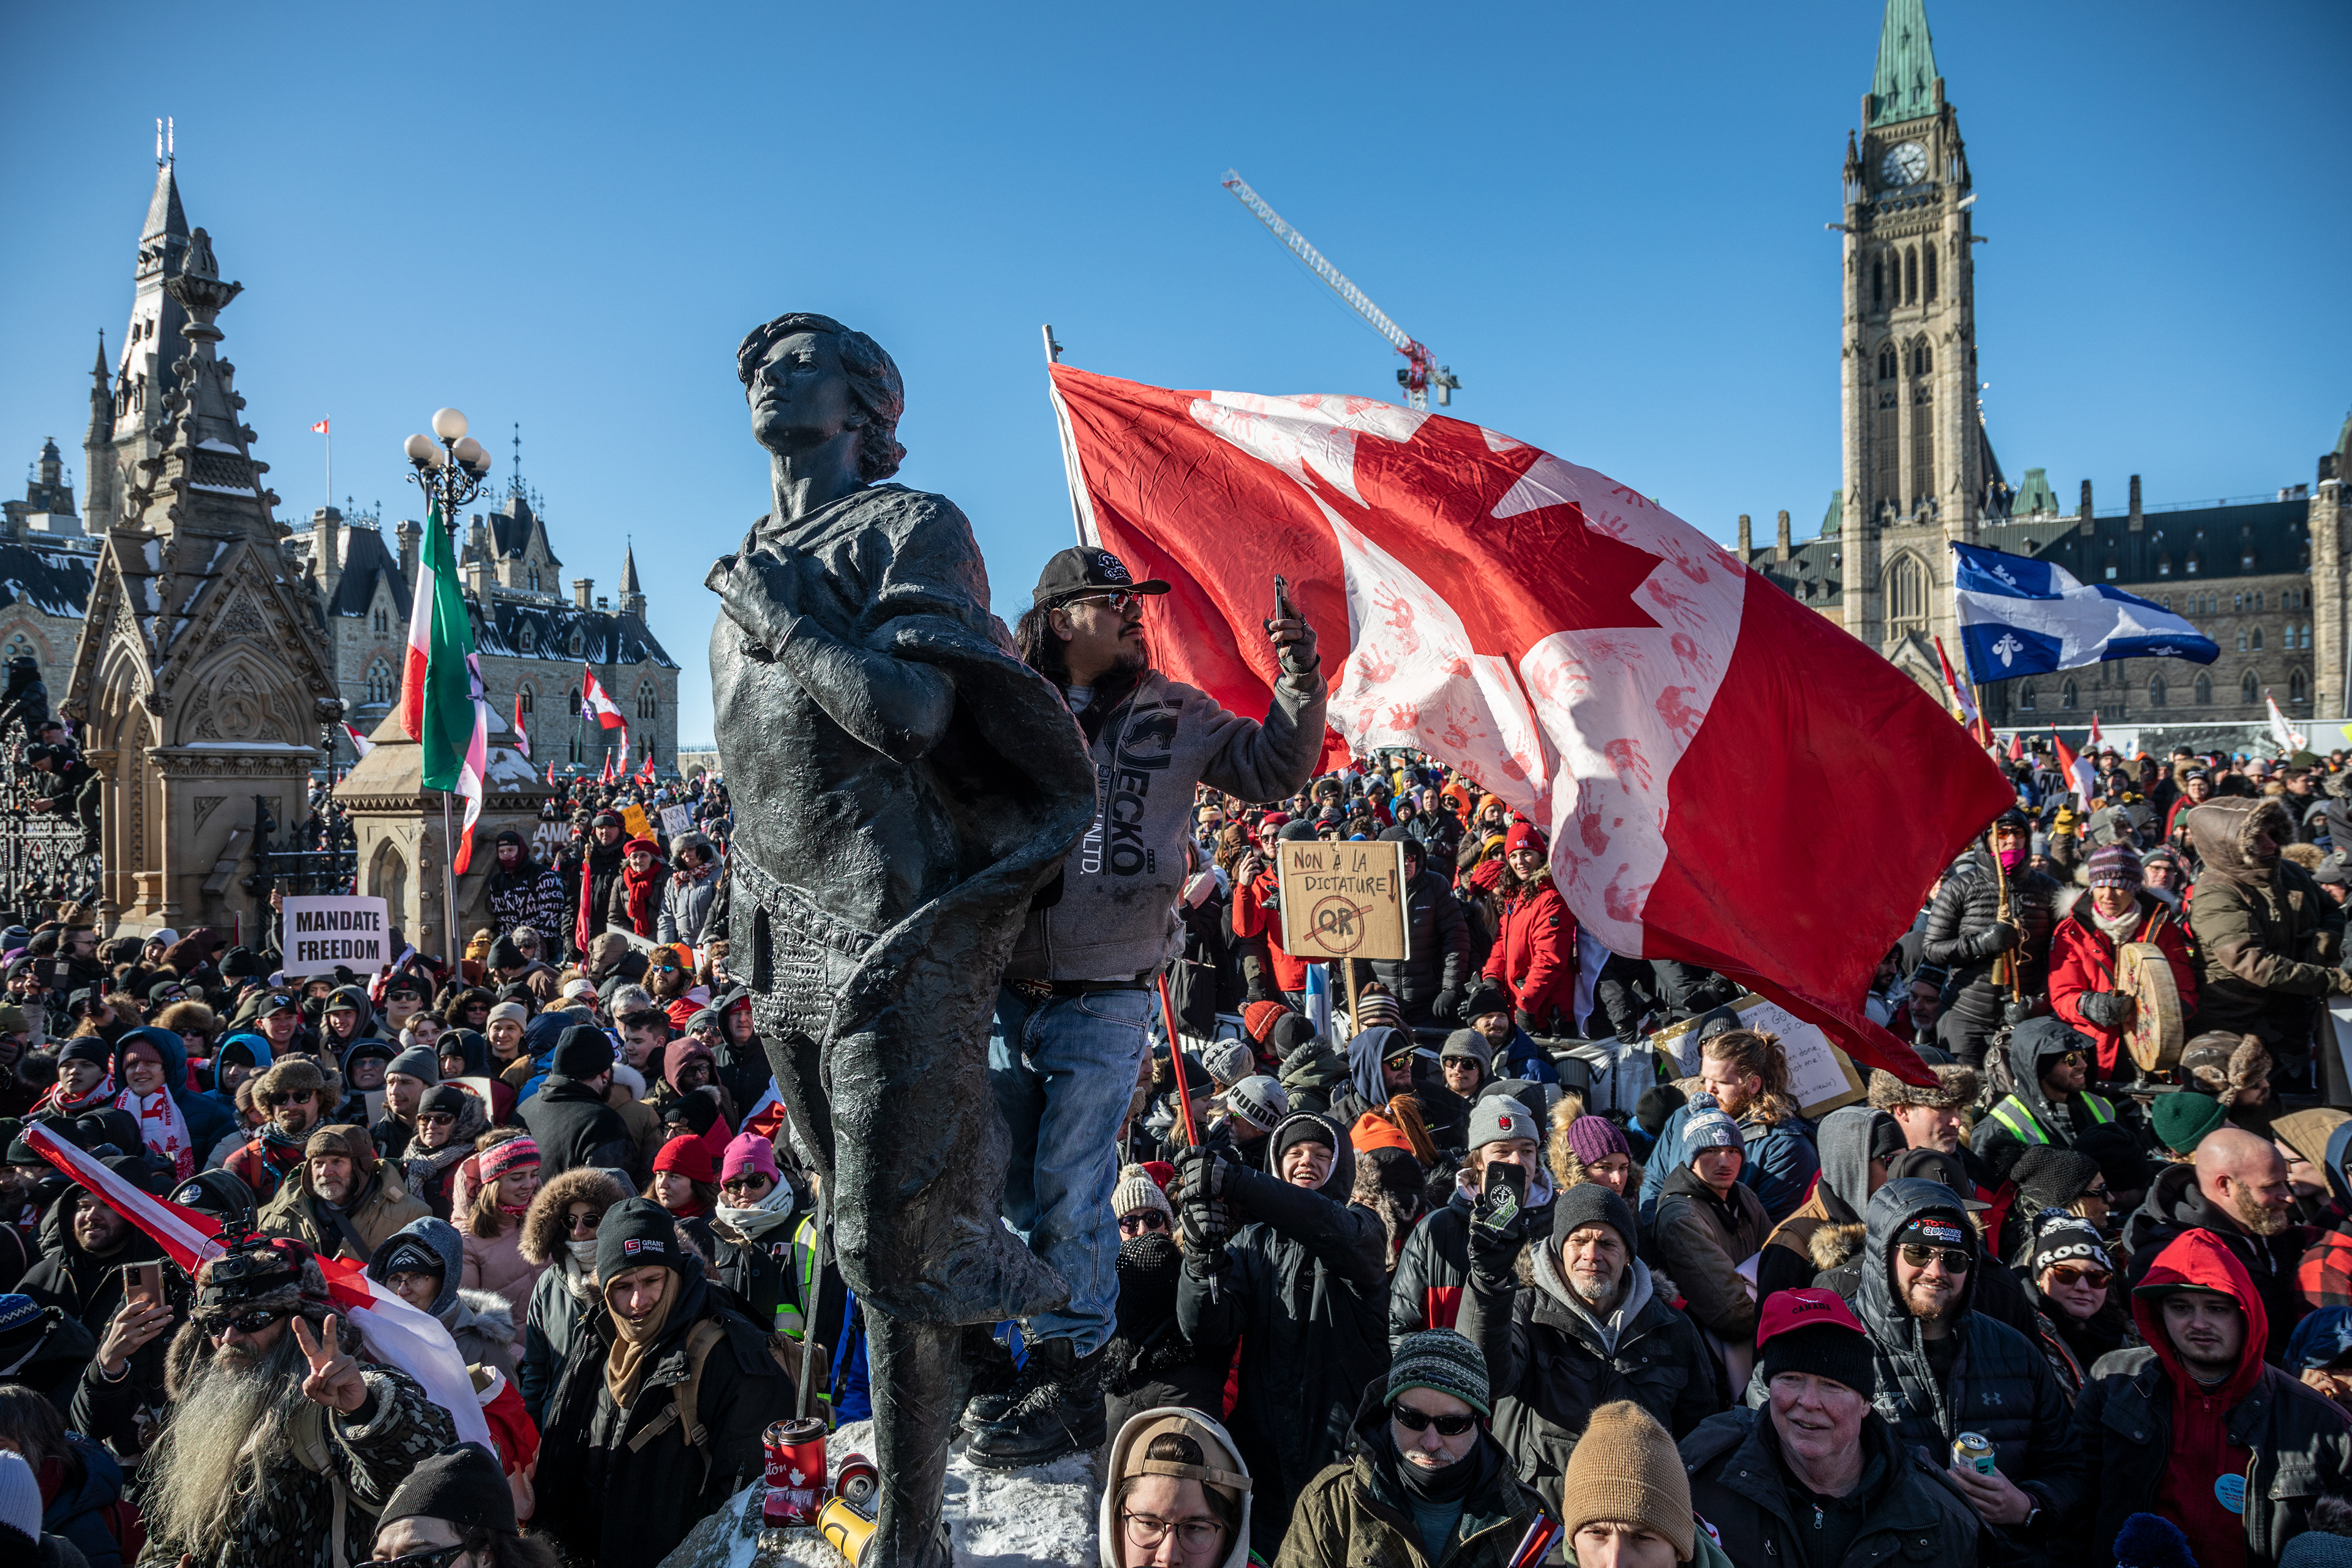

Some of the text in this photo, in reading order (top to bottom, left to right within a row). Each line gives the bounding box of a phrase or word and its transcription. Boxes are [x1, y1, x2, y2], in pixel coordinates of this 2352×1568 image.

[664, 807, 685, 821] NON
[1111, 768, 1150, 876] ECKO
[533, 823, 574, 842] ANK
[1294, 846, 1366, 872] NON À LA
[296, 911, 380, 932] MANDATE
[1319, 907, 1354, 935] QR
[298, 939, 379, 962] FREEDOM
[1229, 1086, 1278, 1128] PUMA
[1684, 1114, 1720, 1134] MAPLE
[1493, 1186, 1502, 1194] EAST
[1923, 1219, 1958, 1229] TOTAL
[1923, 1226, 1961, 1238] QUARTZ
[1792, 1303, 1832, 1314] CANADA
[845, 1502, 862, 1514] SECOND
